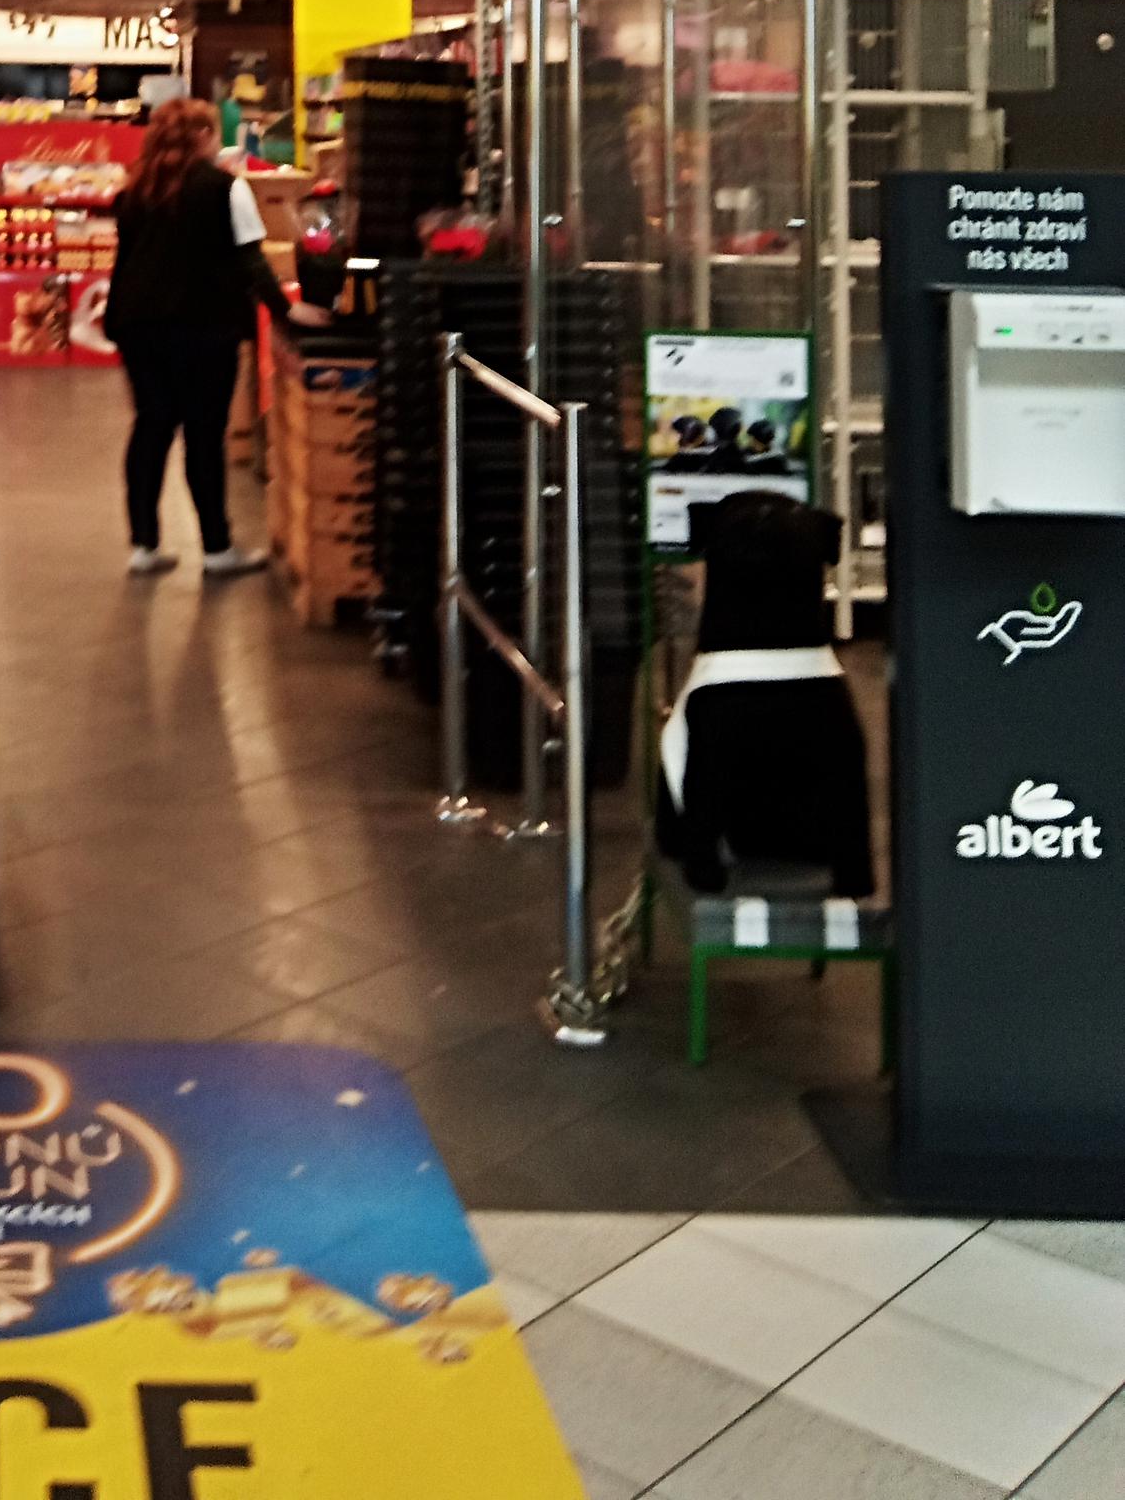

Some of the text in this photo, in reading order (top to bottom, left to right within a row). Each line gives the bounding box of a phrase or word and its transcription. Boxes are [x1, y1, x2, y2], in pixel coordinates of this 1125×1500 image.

[948, 184, 1085, 211] Pomozte nám
[947, 215, 1088, 241] chránit zdraví
[967, 245, 1069, 270] nás všech
[955, 814, 1103, 859] albert
